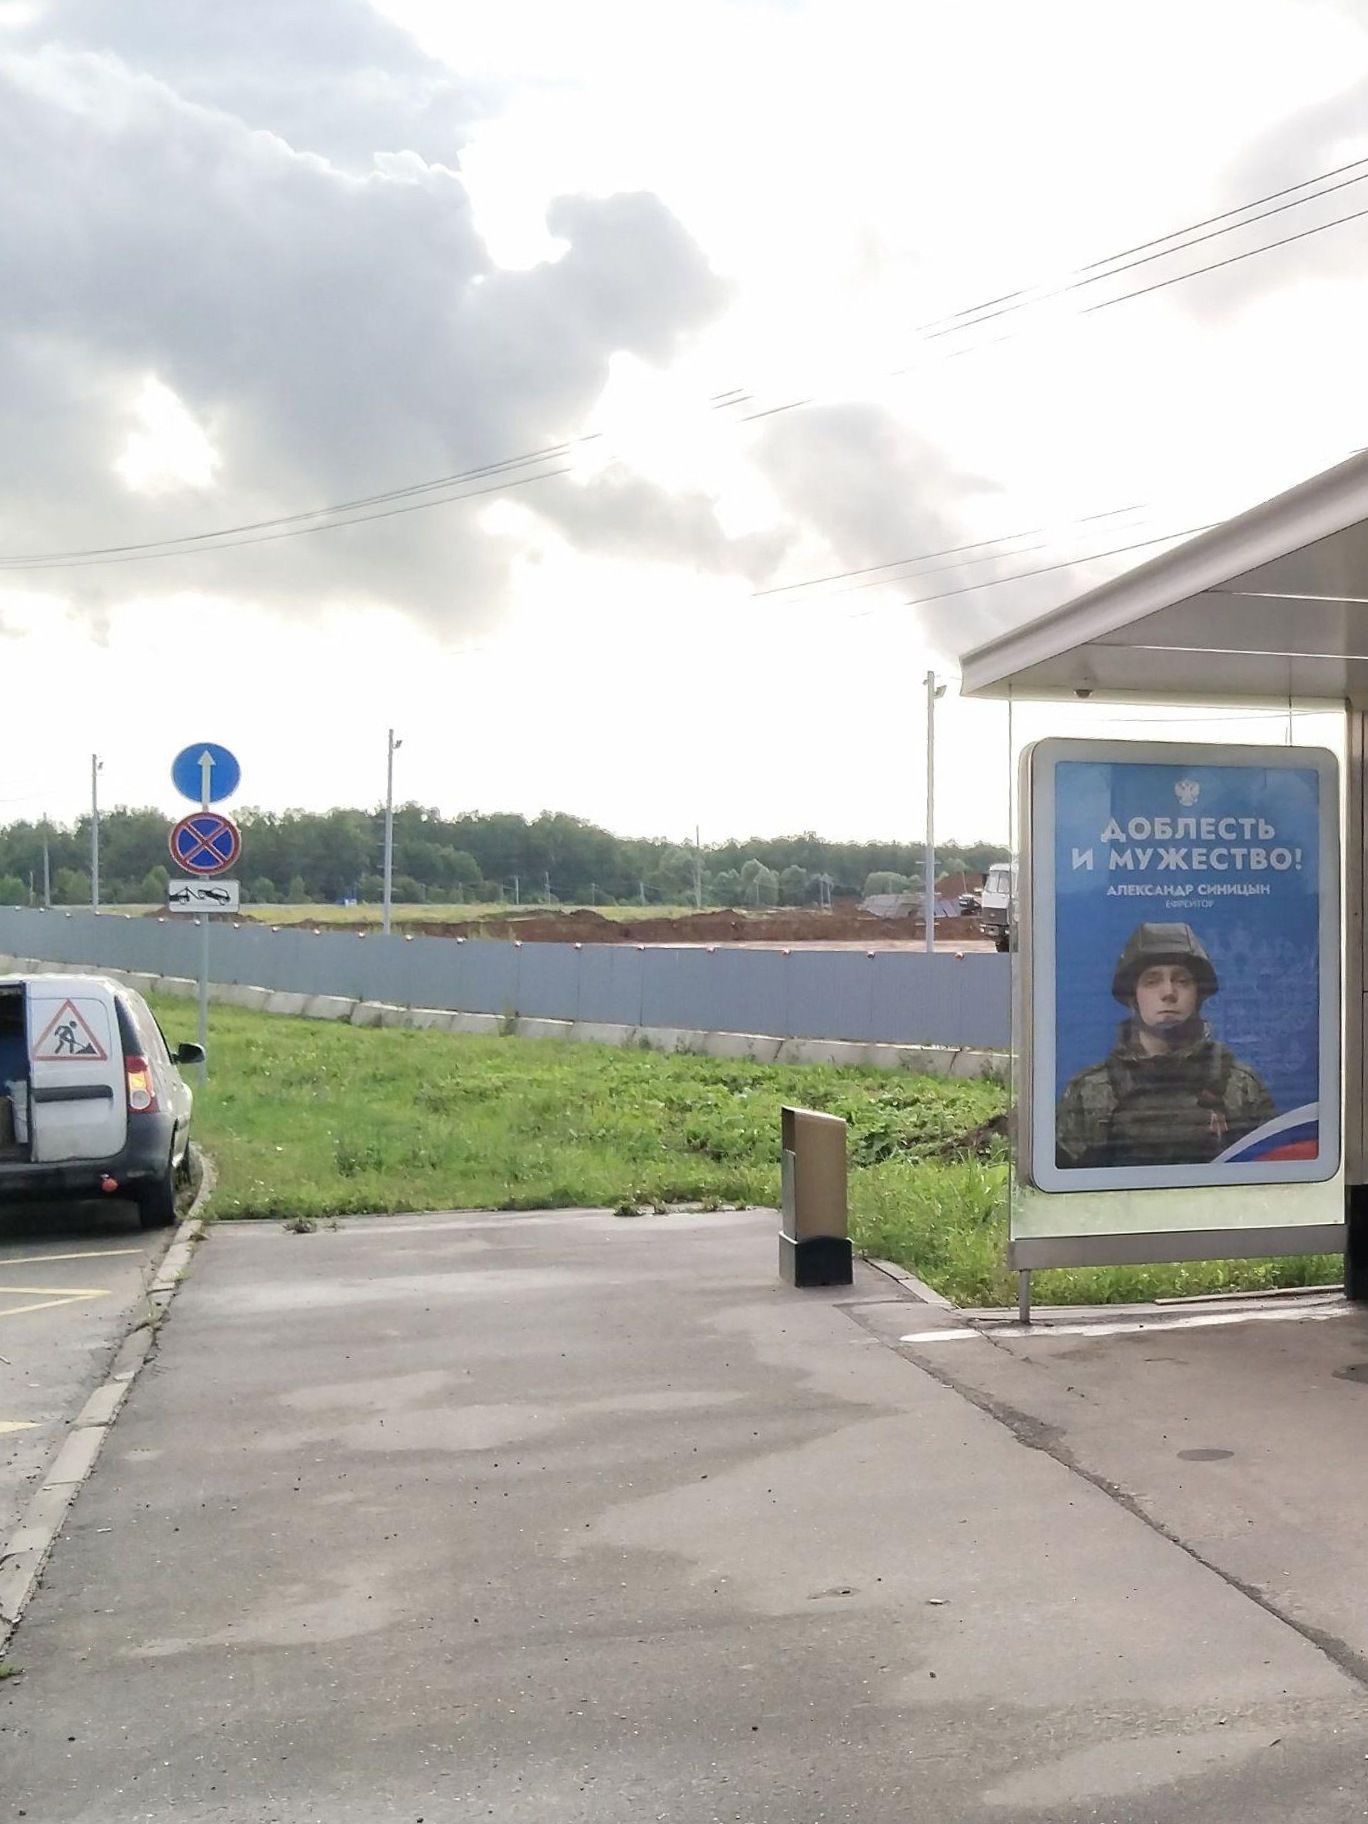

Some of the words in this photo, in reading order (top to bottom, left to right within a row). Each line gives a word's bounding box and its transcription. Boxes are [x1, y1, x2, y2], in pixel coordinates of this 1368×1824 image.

[1100, 816, 1276, 843] ДОБЛЕСТЬ
[1071, 847, 1094, 870] И
[1109, 847, 1302, 871] МУЖЕСТВО!
[1106, 884, 1193, 897] АЛЕКСАНДР
[1197, 884, 1270, 896] СИНИЦЫН
